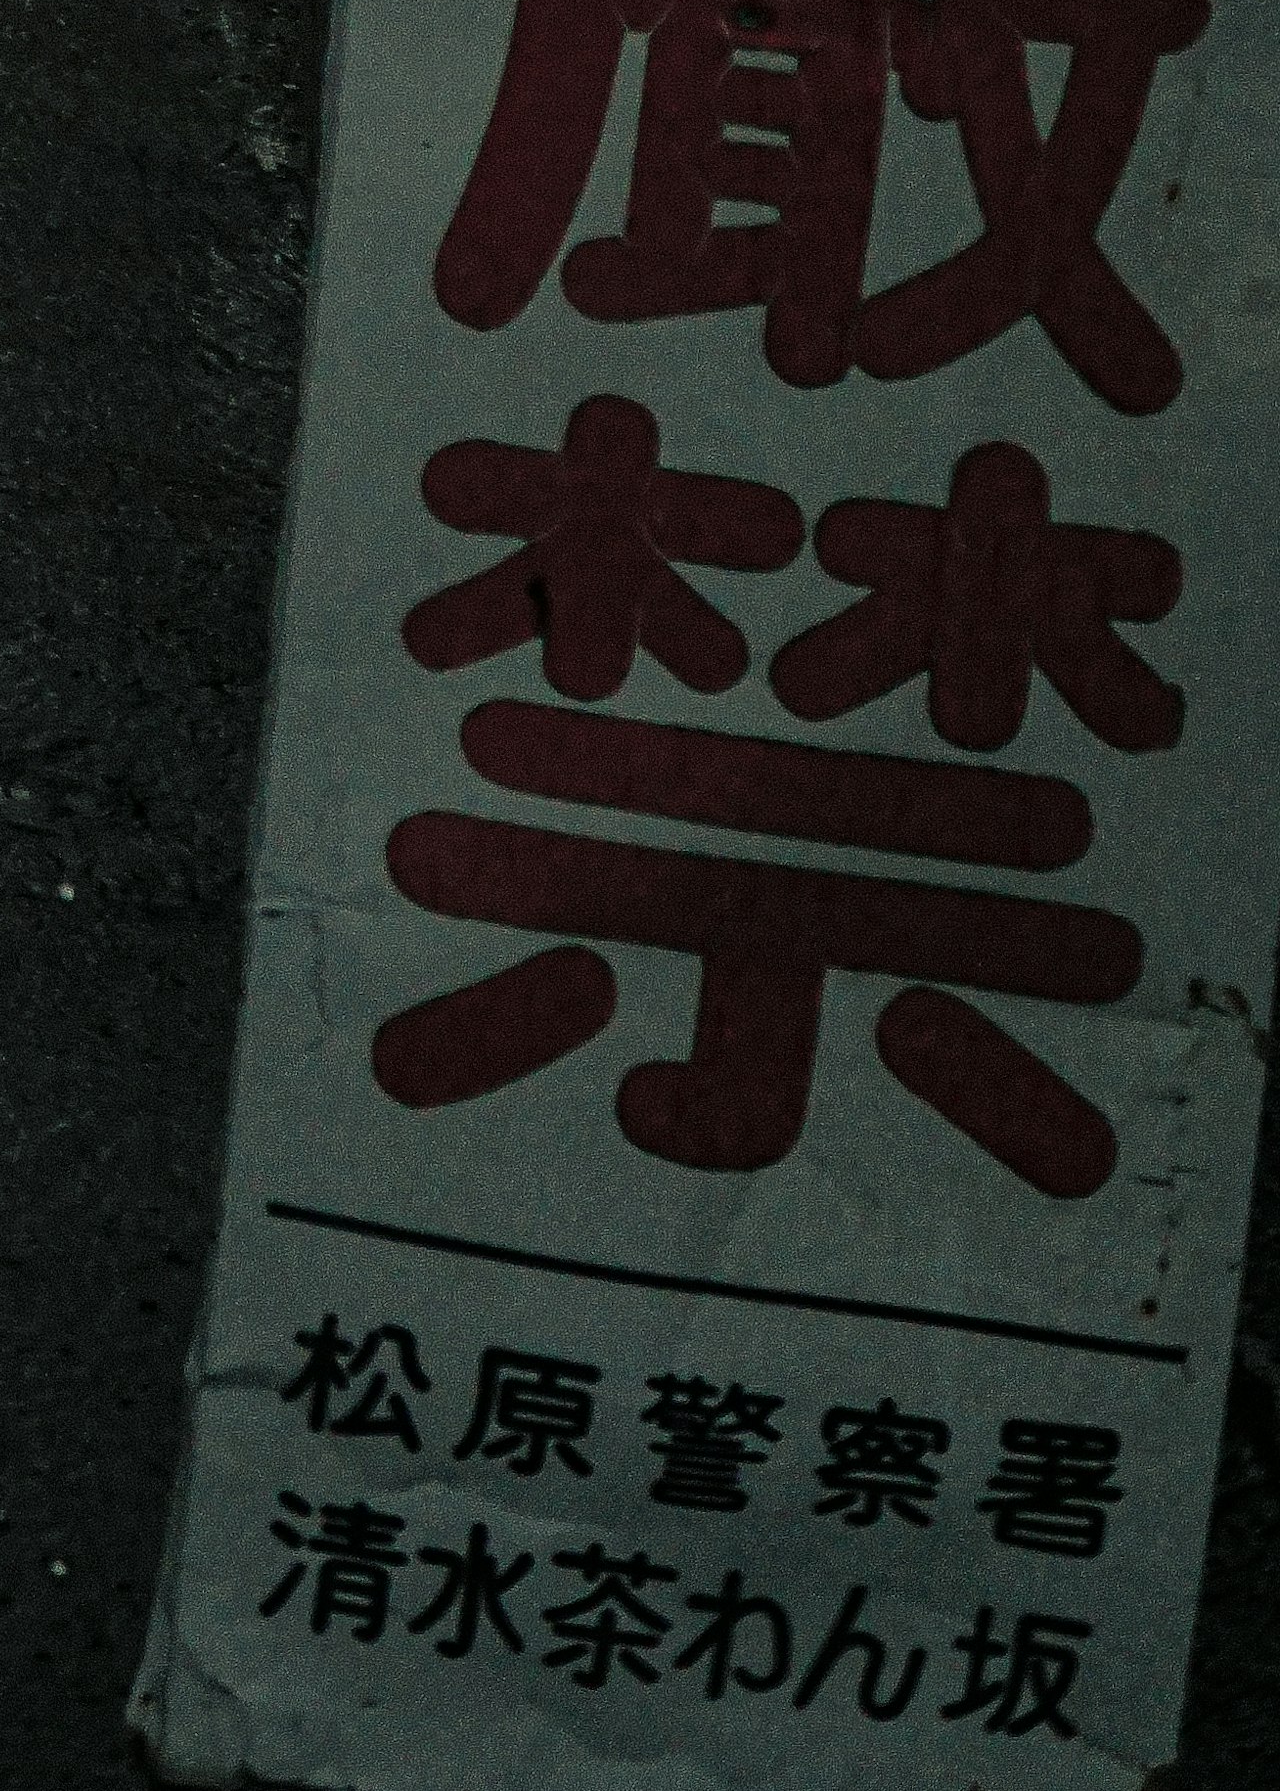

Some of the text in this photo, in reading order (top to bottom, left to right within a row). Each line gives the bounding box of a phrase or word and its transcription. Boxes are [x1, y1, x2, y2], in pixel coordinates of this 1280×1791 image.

[279, 1312, 1125, 1560] 松原警察署
[257, 1488, 1092, 1741] 清水茶わん坂
